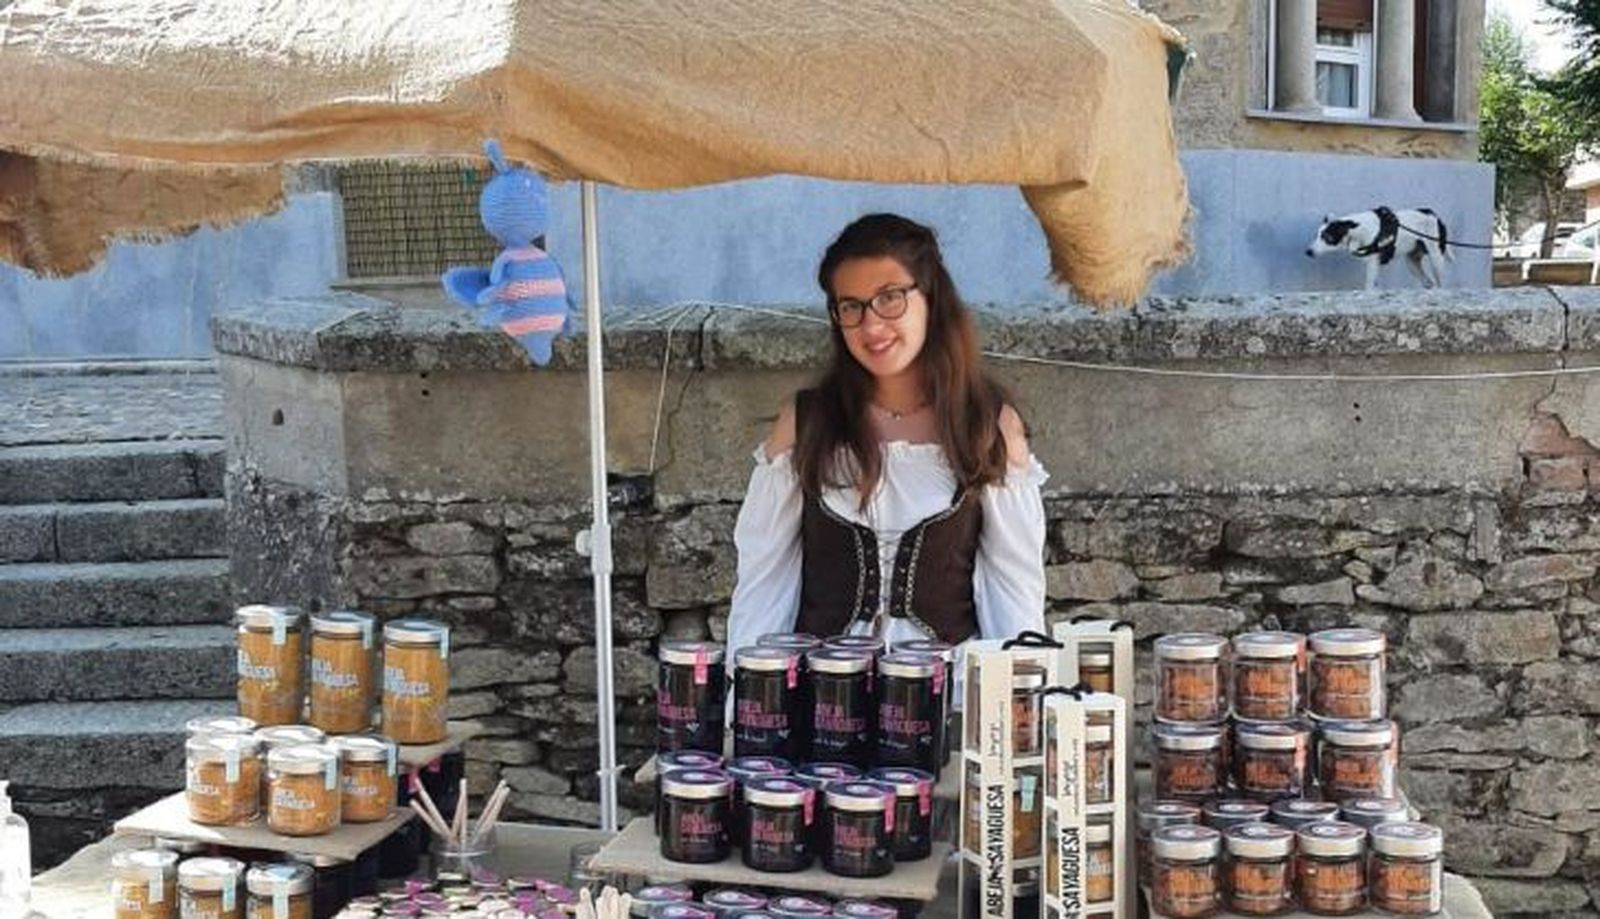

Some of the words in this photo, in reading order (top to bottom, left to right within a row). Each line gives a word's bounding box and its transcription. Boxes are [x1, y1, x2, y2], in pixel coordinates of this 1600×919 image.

[986, 784, 1005, 863] SAYAGUESA
[986, 874, 1004, 917] ABEJA
[1062, 827, 1082, 911] SAYAGUESA
